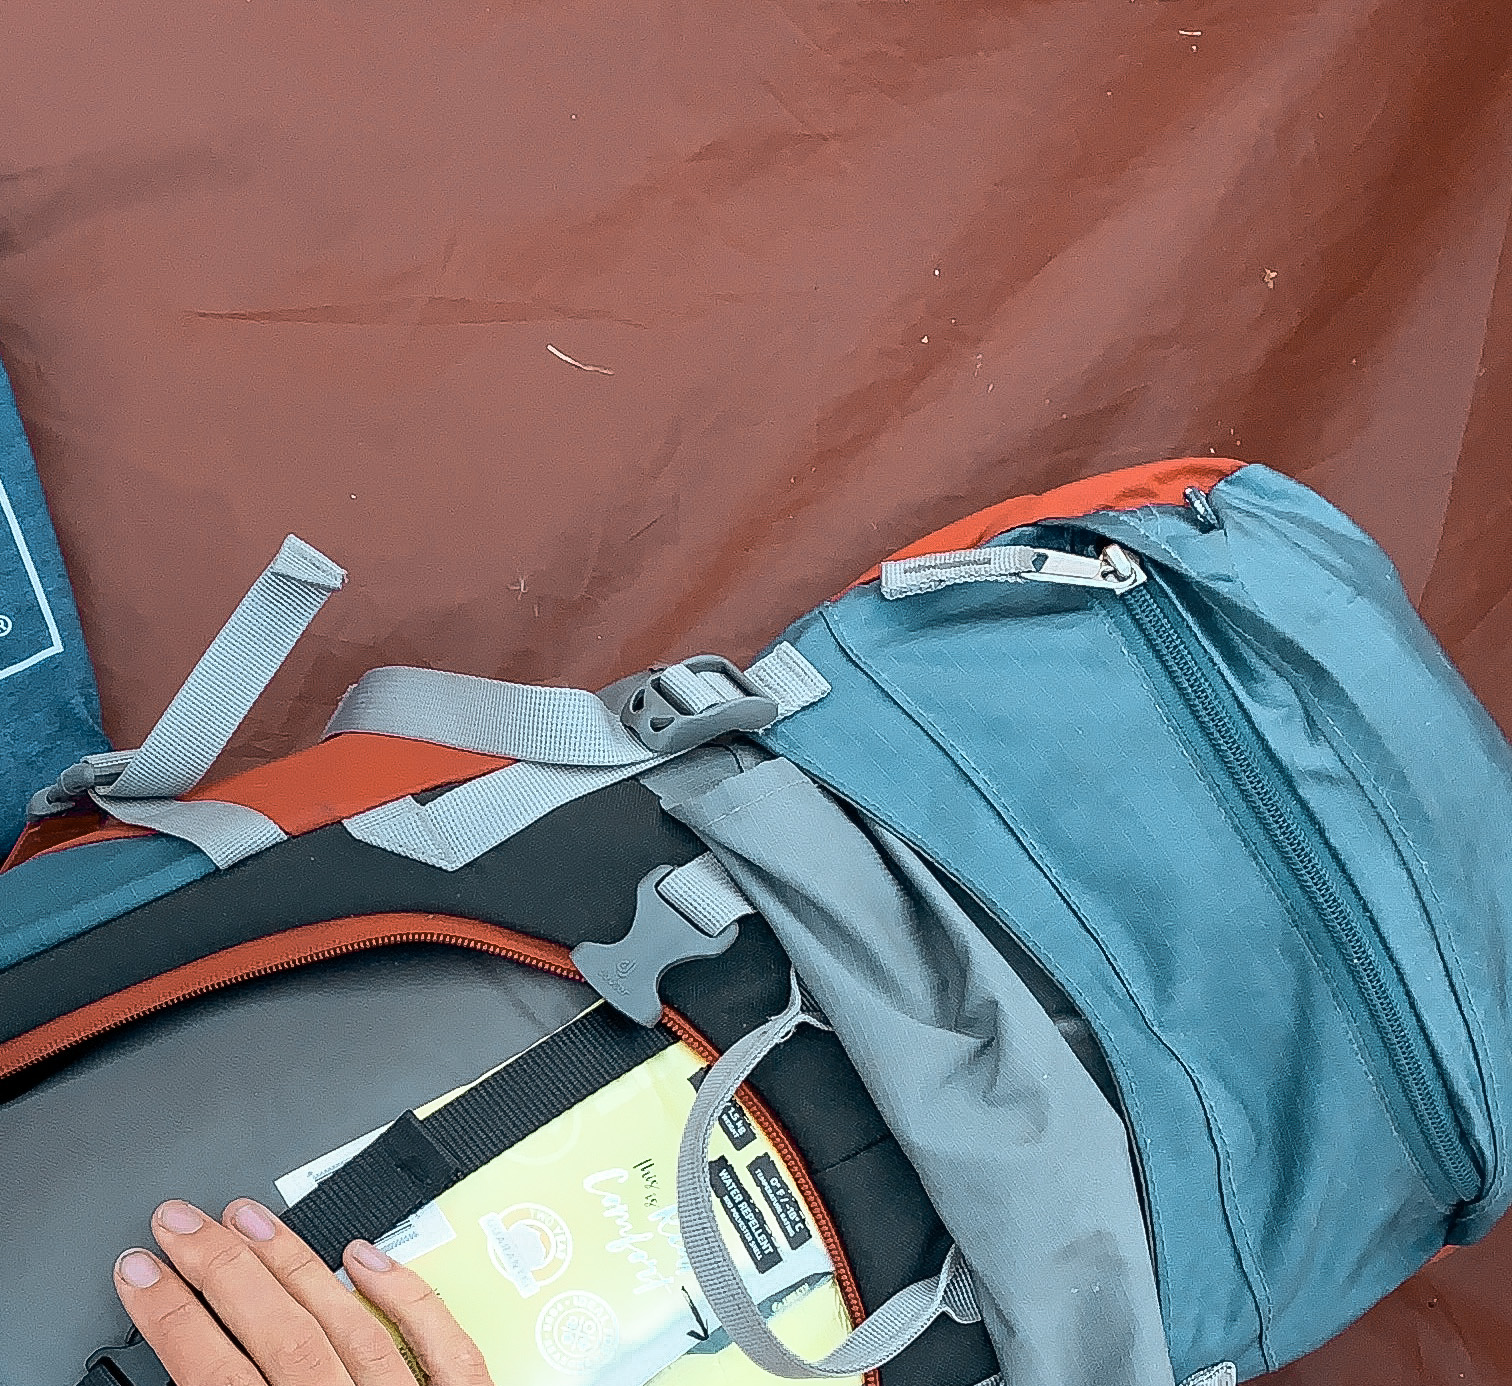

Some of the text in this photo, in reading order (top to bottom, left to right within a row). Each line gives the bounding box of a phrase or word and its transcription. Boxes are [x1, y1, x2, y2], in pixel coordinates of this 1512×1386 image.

[583, 1167, 675, 1295] Comfort
[718, 1168, 774, 1255] WATER REPELLENT
